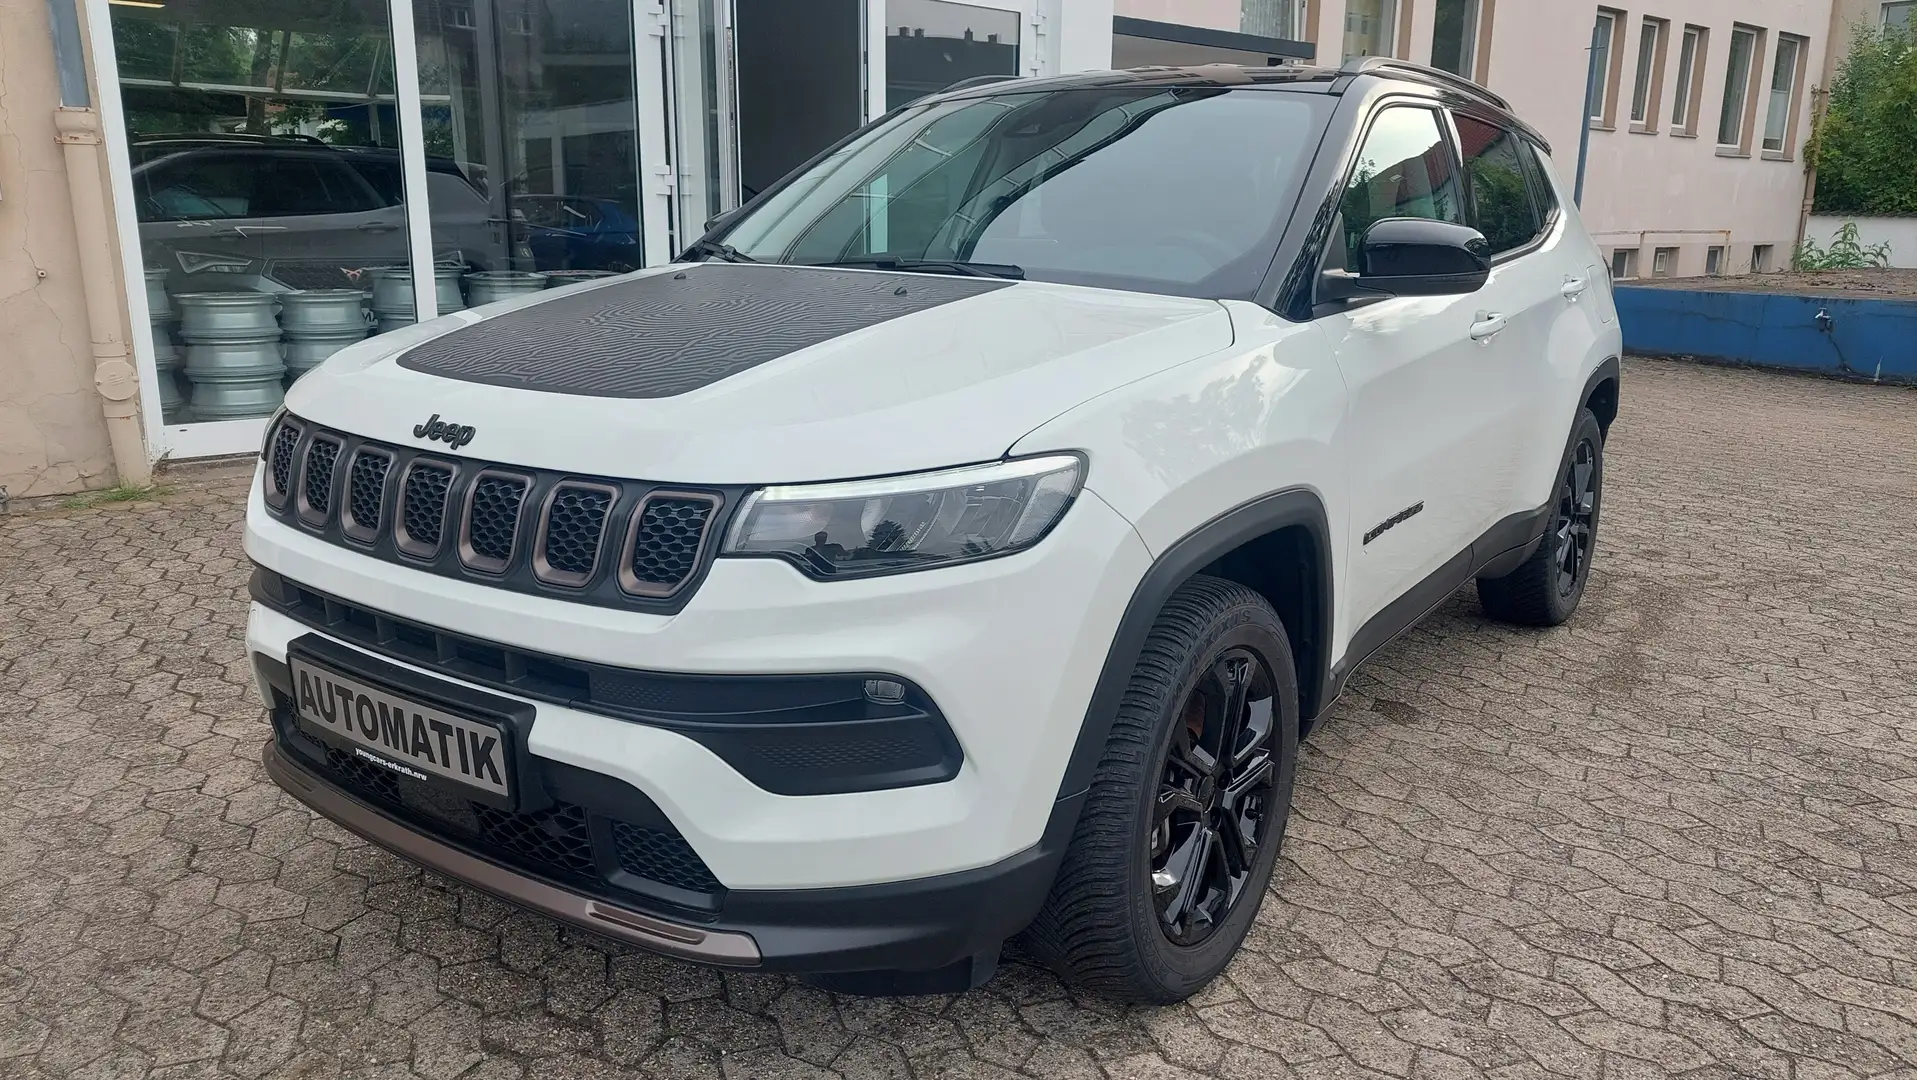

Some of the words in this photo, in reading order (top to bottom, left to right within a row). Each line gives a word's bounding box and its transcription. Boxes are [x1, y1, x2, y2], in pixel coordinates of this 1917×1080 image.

[413, 413, 476, 450] Jeep
[300, 669, 503, 786] AUTOMATIK
[355, 747, 427, 781] youngcars-erkrath.nrw
